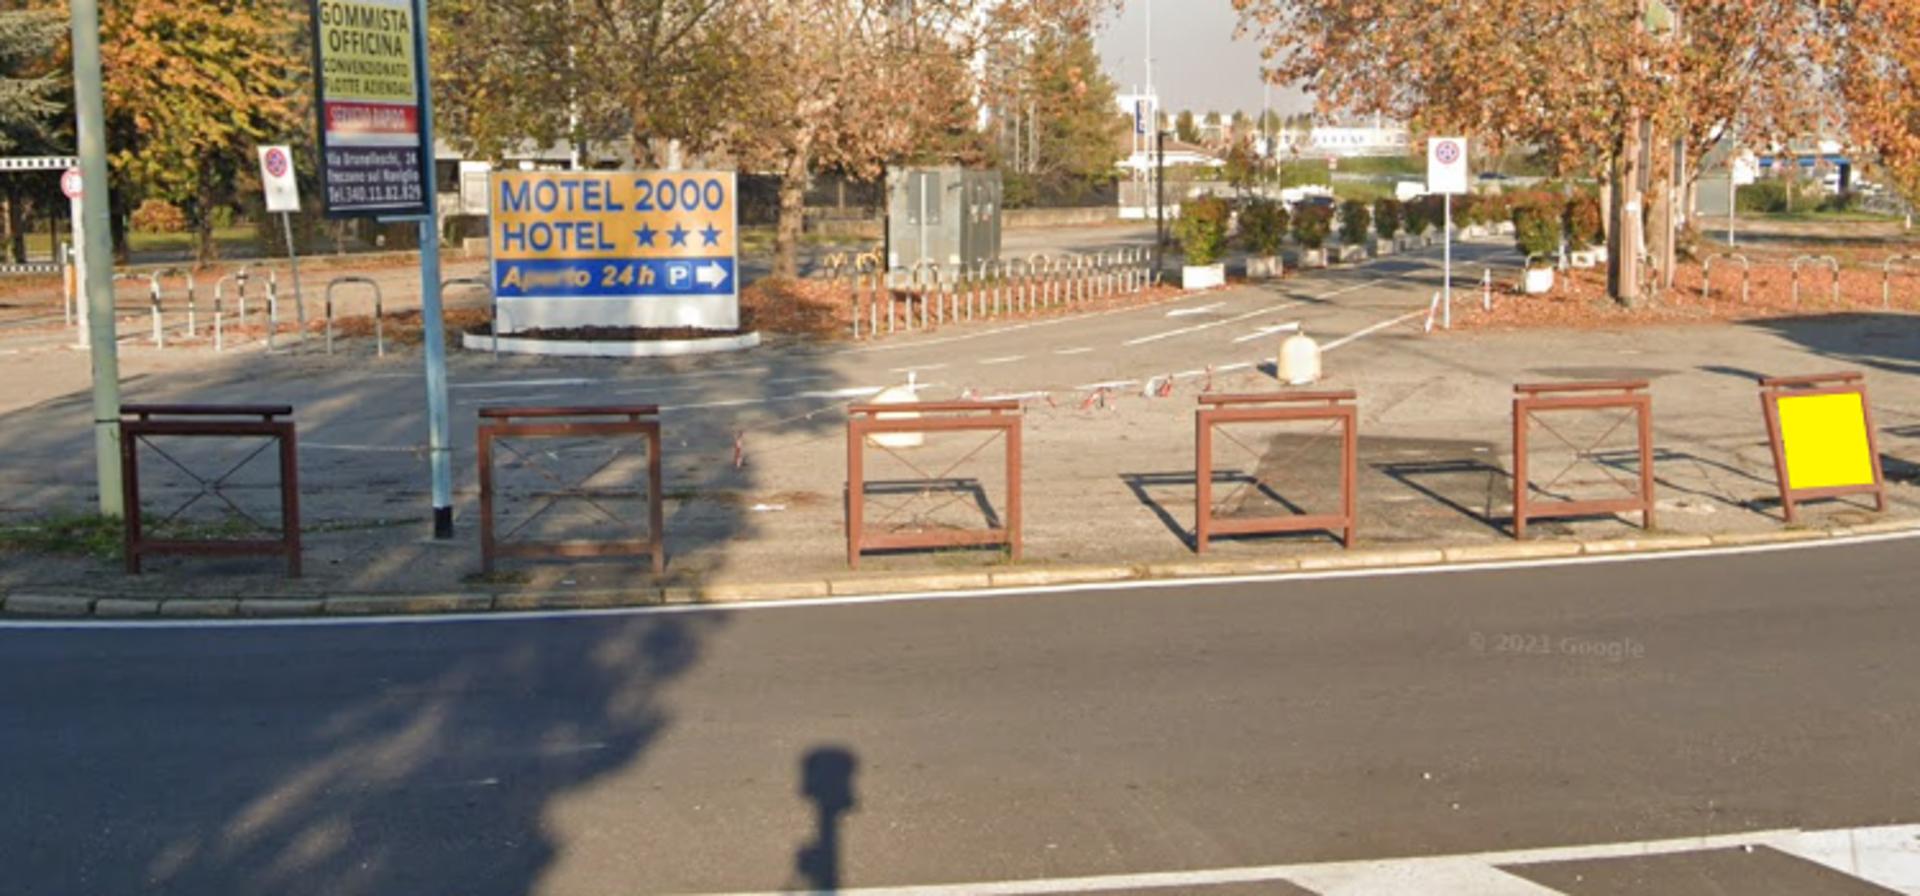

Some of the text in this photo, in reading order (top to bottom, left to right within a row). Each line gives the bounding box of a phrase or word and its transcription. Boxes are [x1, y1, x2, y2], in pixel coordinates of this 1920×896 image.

[320, 2, 408, 33] GOMMISTA
[329, 29, 404, 57] OFFICINA
[324, 58, 407, 78] CONVENZIONATO
[327, 152, 340, 165] Via
[368, 170, 379, 182] sul
[383, 169, 419, 184] Naviglio
[501, 179, 724, 212] MOTEL 2000
[503, 222, 617, 250] HOTEL
